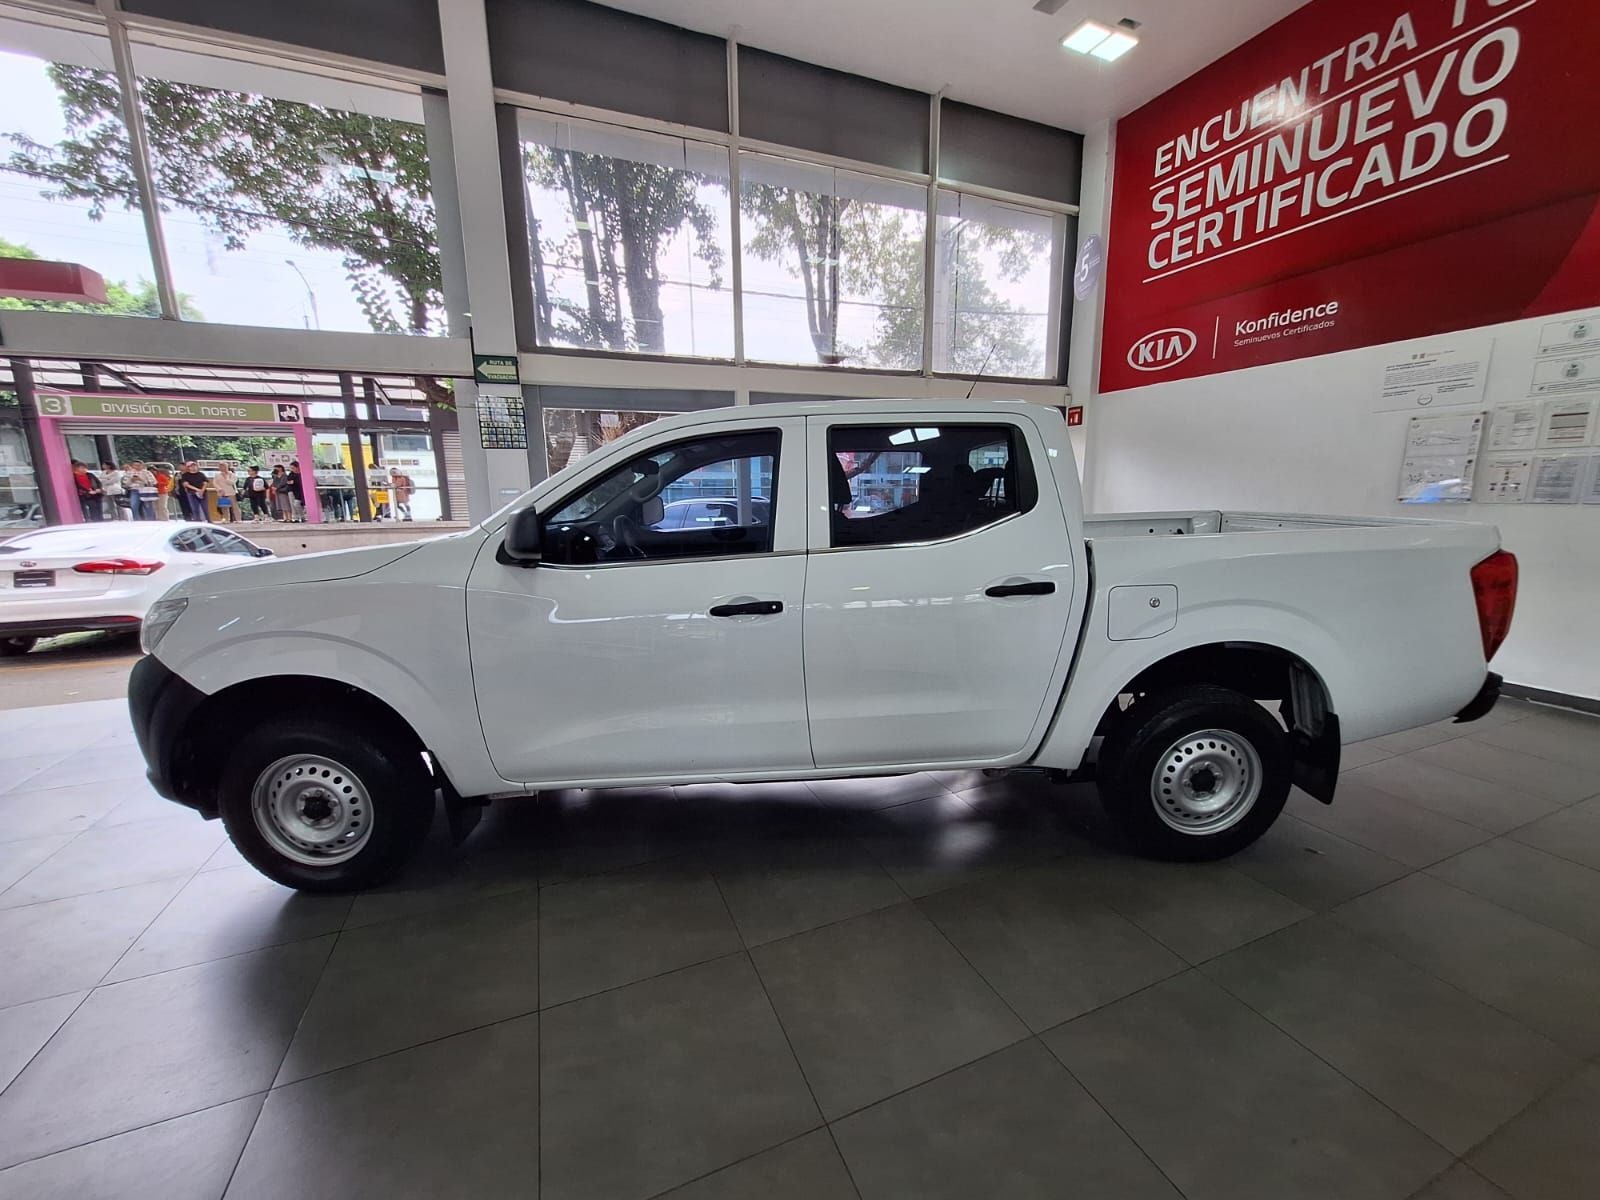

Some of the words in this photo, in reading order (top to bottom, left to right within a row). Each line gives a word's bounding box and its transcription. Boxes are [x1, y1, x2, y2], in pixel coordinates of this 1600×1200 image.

[1154, 12, 1418, 178] ENCUENTRA
[1150, 27, 1520, 230] SEMINUEVO
[1147, 98, 1508, 270] CERTIFICADO
[1233, 331, 1281, 347] Seminuevos
[1282, 319, 1335, 337] Certificados
[1234, 301, 1339, 336] Konfidence
[1137, 335, 1184, 365] KIA
[45, 398, 61, 413] 3
[168, 406, 195, 416] DEL
[201, 407, 248, 417] NORTE
